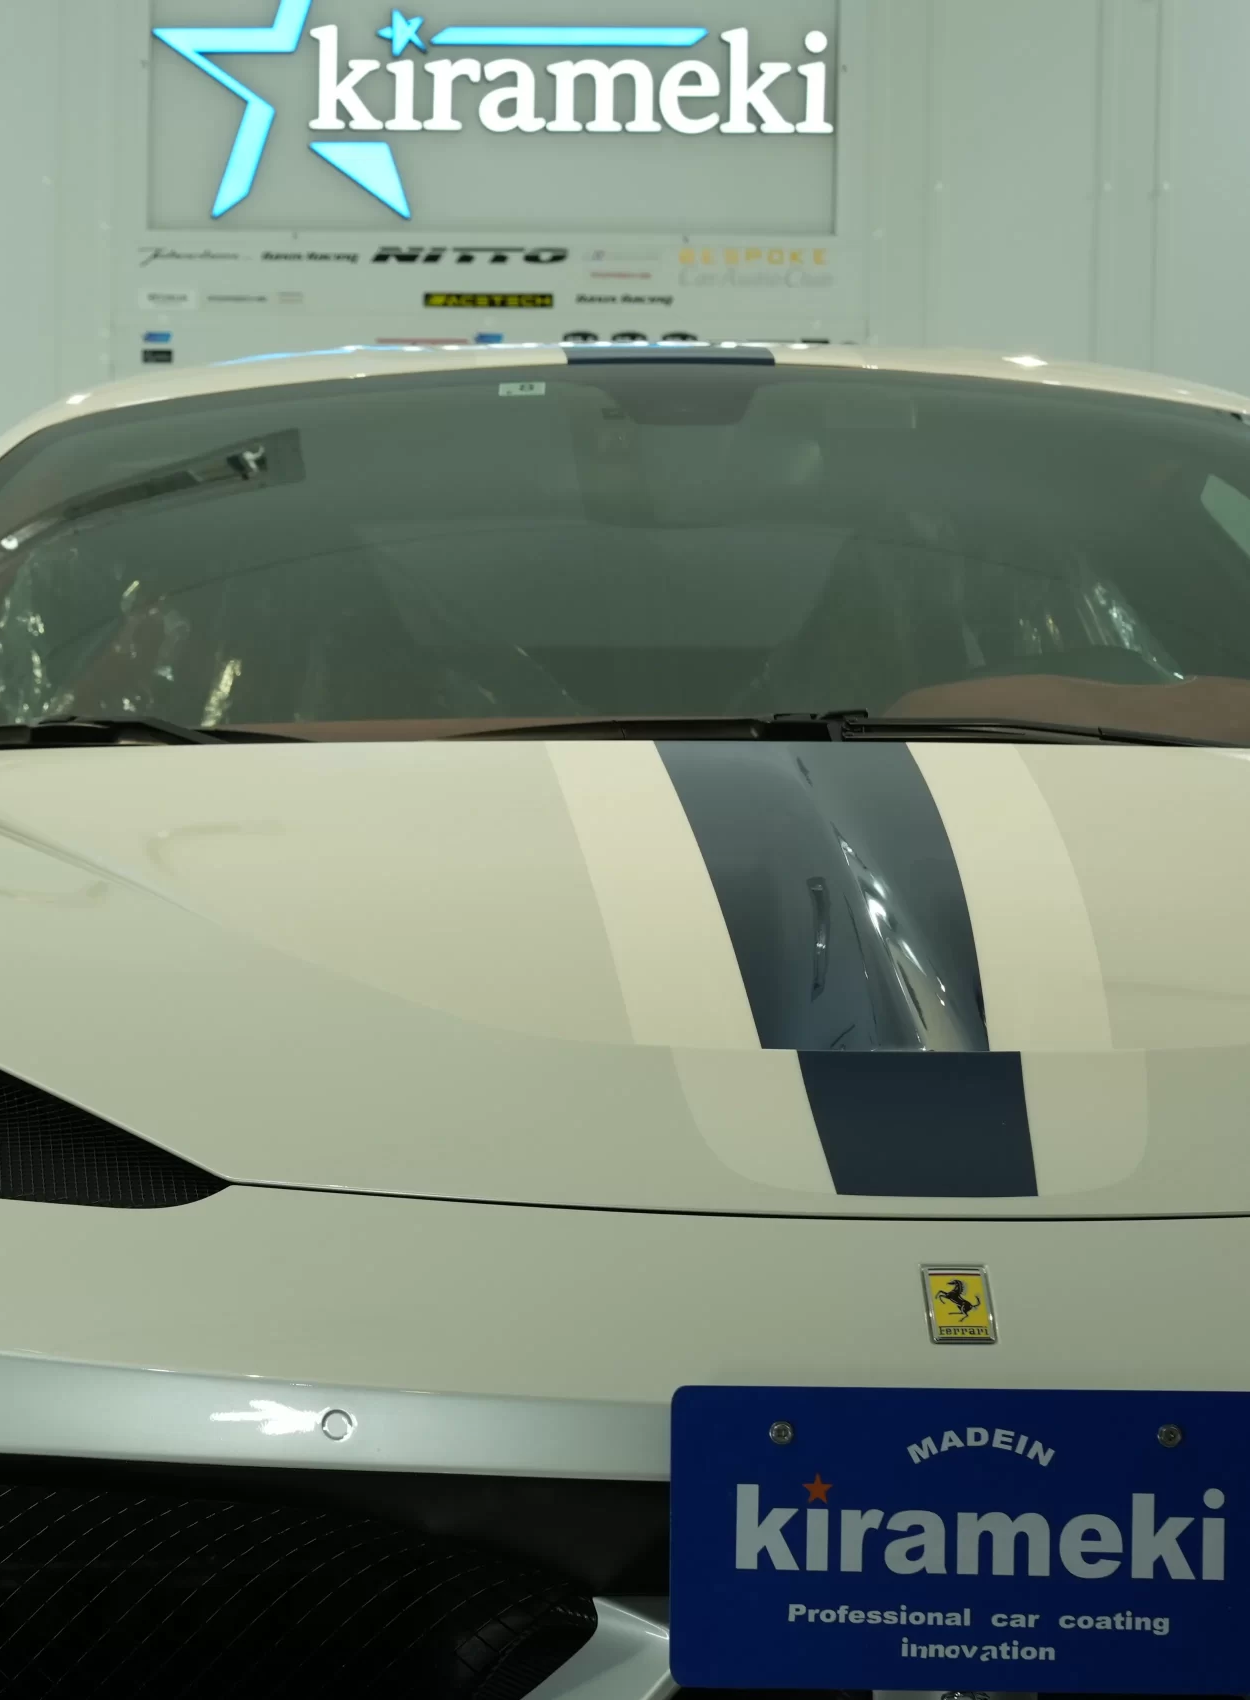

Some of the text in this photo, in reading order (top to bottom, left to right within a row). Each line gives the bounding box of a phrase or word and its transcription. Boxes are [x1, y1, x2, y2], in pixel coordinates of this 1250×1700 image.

[309, 24, 833, 134] kirameki
[370, 246, 570, 264] NITTO
[938, 1326, 989, 1336] Ferrari
[735, 1479, 1226, 1581] kirameki
[787, 1603, 1170, 1636] Professional car coating
[901, 1637, 1056, 1662] innovation
